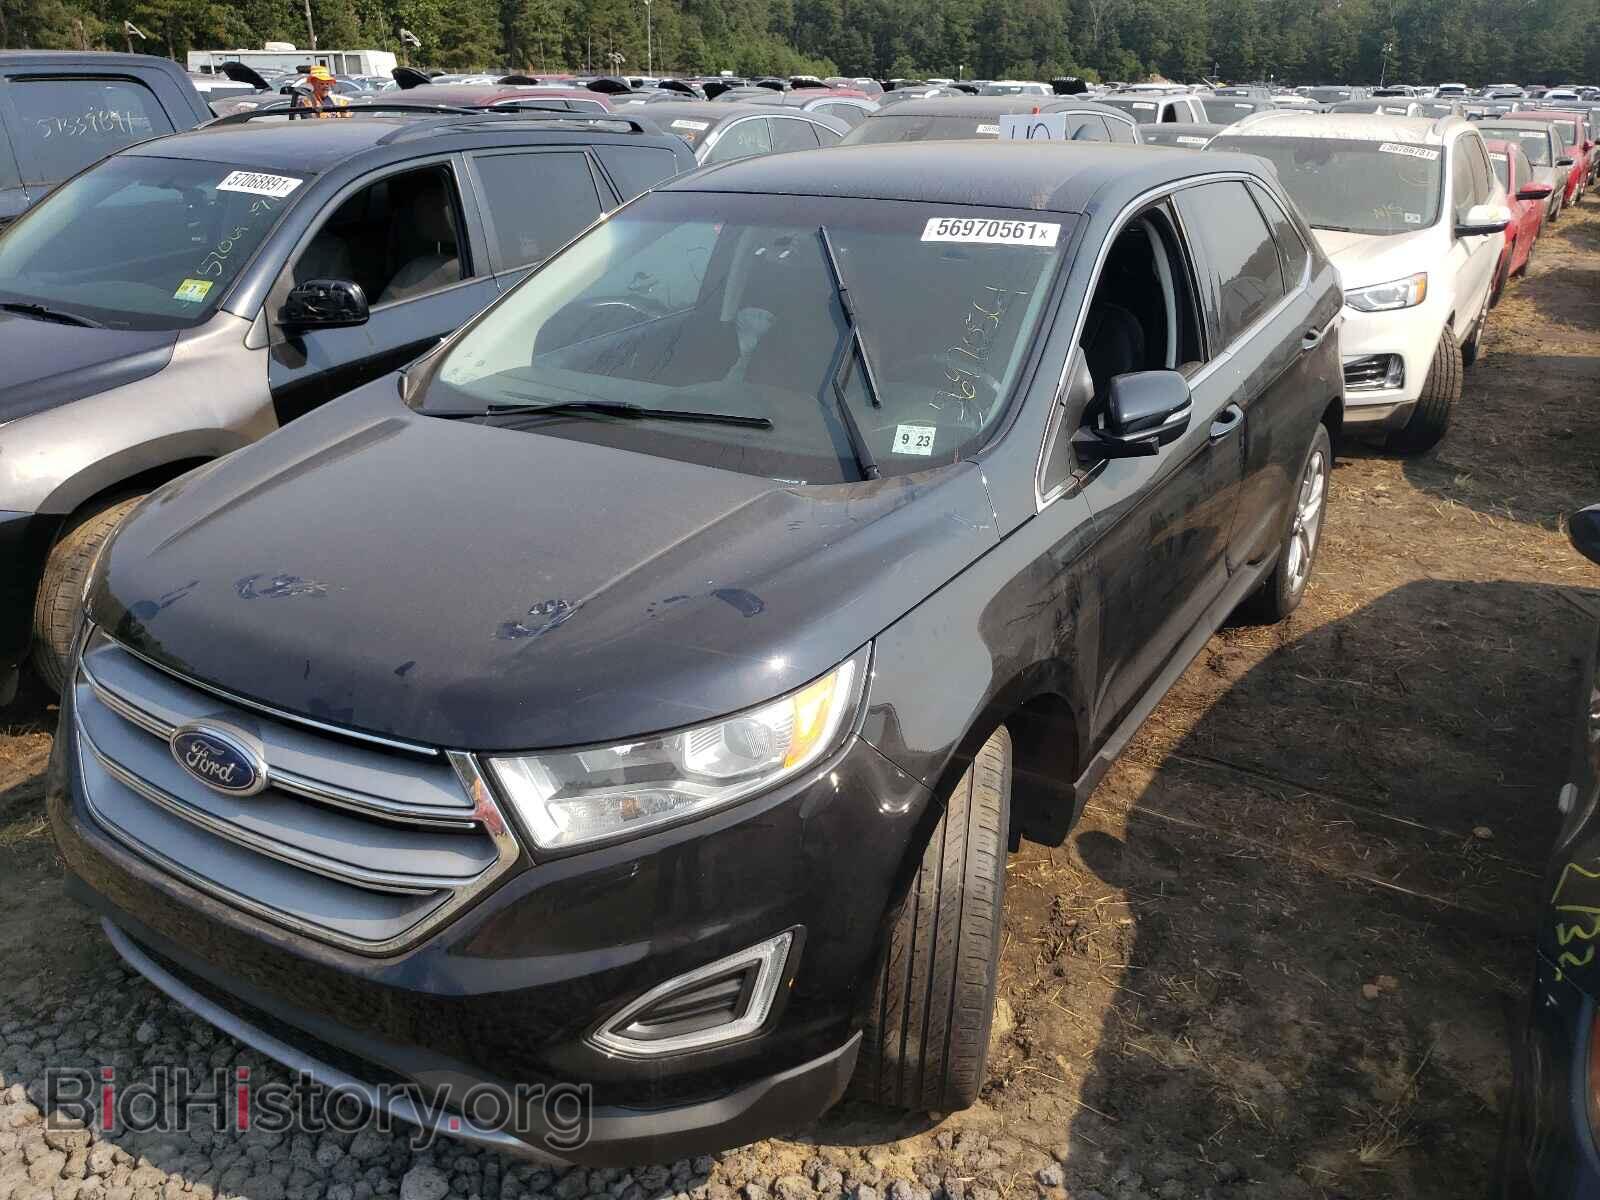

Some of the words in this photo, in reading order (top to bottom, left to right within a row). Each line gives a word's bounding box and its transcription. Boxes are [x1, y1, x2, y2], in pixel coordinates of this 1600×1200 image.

[902, 433, 909, 444] 9
[916, 435, 930, 447] 23
[186, 740, 235, 782] Ford
